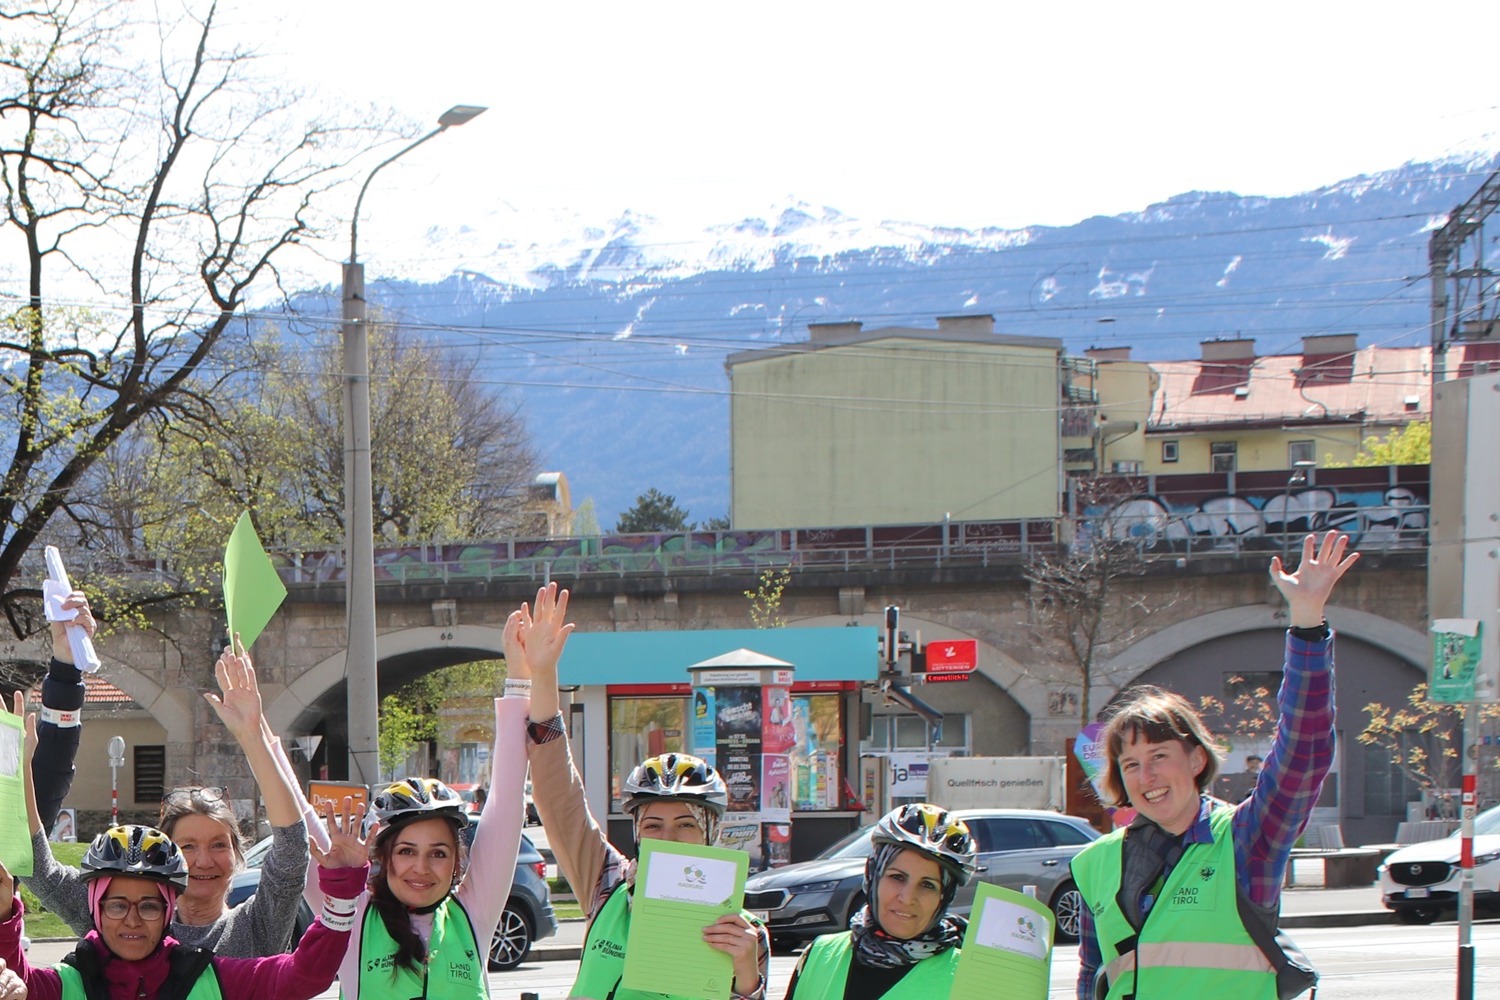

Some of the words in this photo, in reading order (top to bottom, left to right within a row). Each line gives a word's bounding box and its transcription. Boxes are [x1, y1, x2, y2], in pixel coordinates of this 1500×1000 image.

[440, 632, 453, 640] 66
[892, 764, 908, 786] ja
[948, 779, 997, 787] Quellfrisch
[1000, 779, 1043, 788] genießen
[1172, 896, 1198, 904] TIROL
[604, 940, 623, 951] KLIMA
[450, 961, 471, 972] LAND
[450, 970, 472, 981] TIROL
